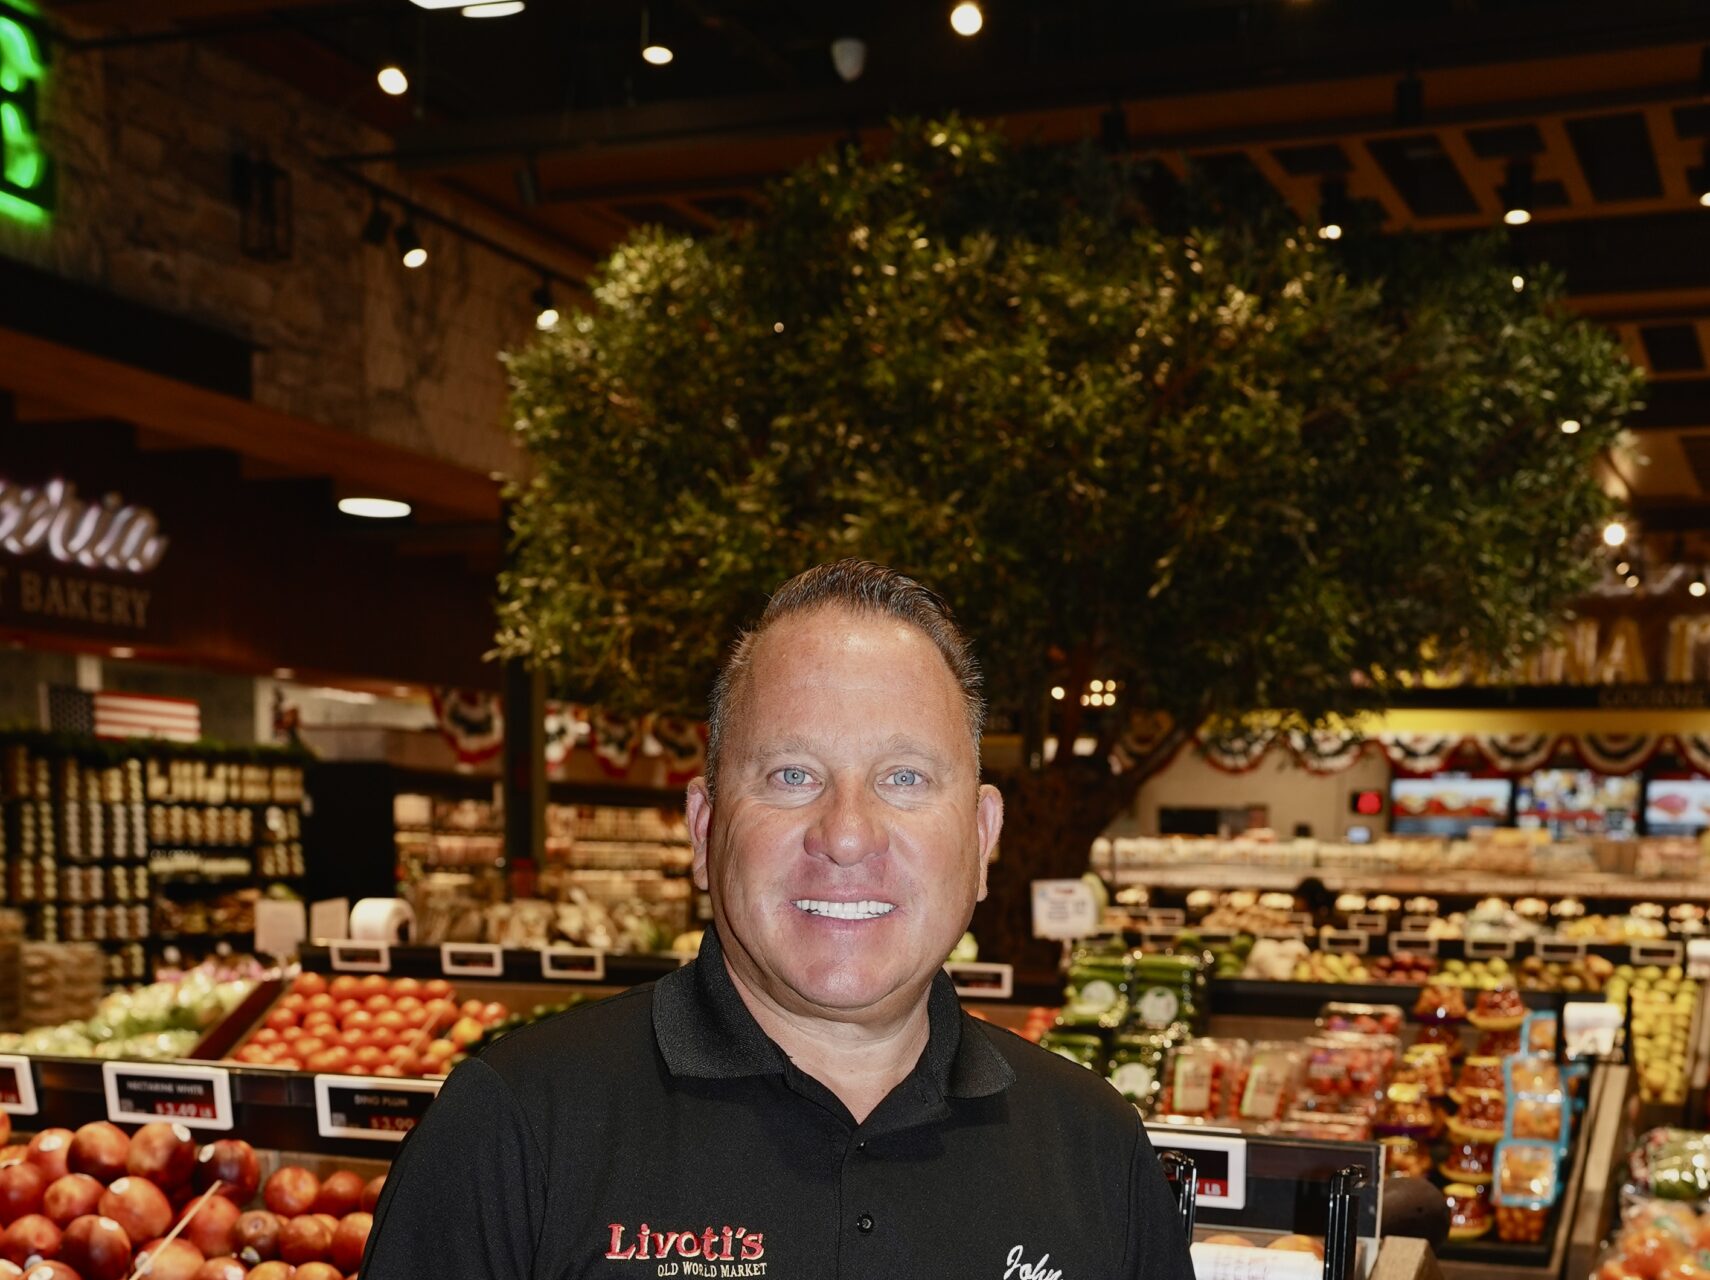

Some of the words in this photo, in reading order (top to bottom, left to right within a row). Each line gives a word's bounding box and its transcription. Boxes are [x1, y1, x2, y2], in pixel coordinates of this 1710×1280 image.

[21, 571, 151, 628] BAKERY
[176, 1084, 204, 1097] WHITE
[1204, 1182, 1221, 1195] LB
[605, 1223, 765, 1261] Livoti's
[657, 1262, 679, 1277] OLD
[682, 1261, 718, 1278] WORLD
[719, 1262, 768, 1278] MARKET
